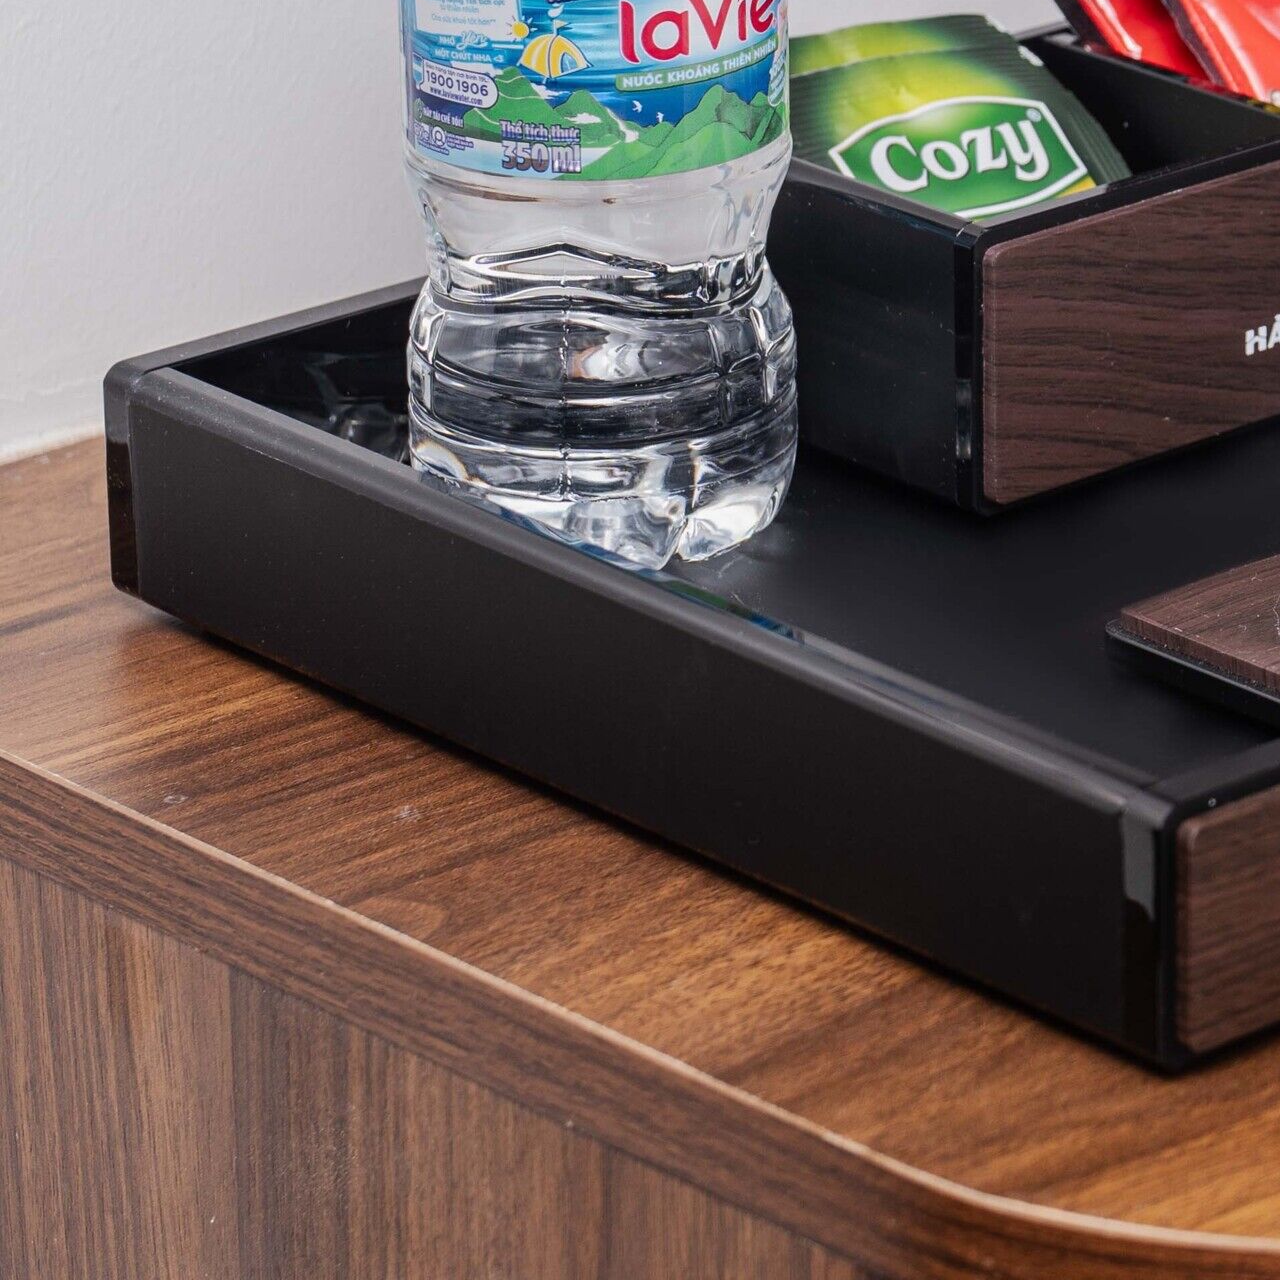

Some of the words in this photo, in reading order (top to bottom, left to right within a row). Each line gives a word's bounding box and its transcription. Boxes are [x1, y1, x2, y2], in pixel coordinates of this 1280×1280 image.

[426, 70, 454, 89] 1900
[456, 79, 489, 97] 1906
[622, 72, 663, 89] NƯỚC
[667, 63, 720, 84] KHOÁNG
[722, 51, 752, 70] THIÊN
[499, 119, 524, 140] Thể
[524, 122, 549, 142] tích
[550, 123, 581, 143] thực
[501, 140, 549, 173] 350
[552, 143, 581, 173] ml
[870, 119, 1050, 192] Cozy
